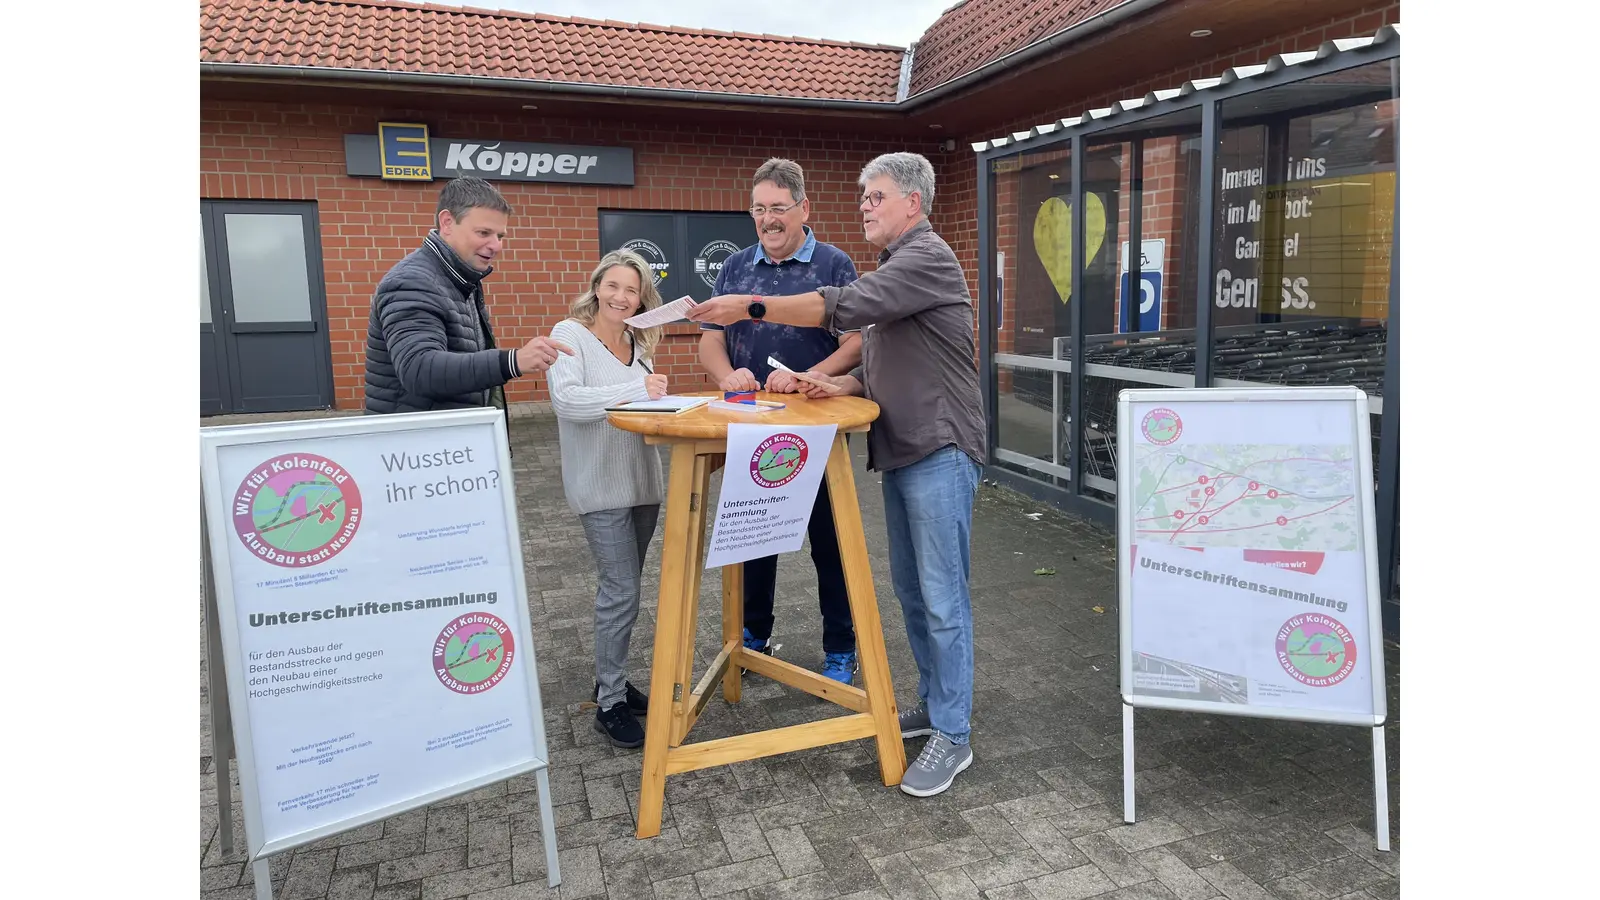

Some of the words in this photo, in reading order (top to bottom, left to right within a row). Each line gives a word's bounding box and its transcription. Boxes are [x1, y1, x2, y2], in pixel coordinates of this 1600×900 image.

[386, 167, 429, 177] EDEKA
[1296, 157, 1326, 180] uns
[1227, 203, 1244, 225] im
[1247, 196, 1312, 222] Abot:
[1235, 236, 1260, 260] Gan
[1215, 269, 1316, 310] Genss.
[381, 446, 474, 472] Wusstet
[752, 449, 762, 463] Wir
[761, 439, 773, 450] für
[774, 435, 806, 450] Kolenfeld
[236, 490, 253, 515] Wir
[247, 469, 269, 488] für
[271, 457, 348, 484] Kolenfeld
[386, 482, 417, 503] ihr
[424, 470, 500, 498] schon?
[721, 508, 767, 519] sammlung
[723, 496, 789, 508] Unterschriften-
[717, 523, 770, 536] Bestandsstrecke
[784, 517, 804, 526] gegen
[743, 517, 768, 525] Ausbau
[243, 532, 295, 564] Ausbau
[299, 548, 331, 564] statt
[330, 508, 359, 551] Neubau
[729, 534, 755, 542] Neubau
[756, 530, 772, 538] einer
[1290, 559, 1307, 568] wir?
[1141, 557, 1348, 613] Unterschriftensammlung
[249, 591, 498, 628] Unterschriftensammlung
[434, 639, 446, 657] Wir
[443, 624, 459, 638] für
[459, 614, 507, 634] Kolenfeld
[1278, 626, 1291, 641] Wir
[1289, 617, 1304, 628] für
[1306, 615, 1352, 643] Kolenfeld
[249, 652, 263, 661] für
[265, 649, 285, 659] den
[287, 645, 324, 656] Ausbau
[327, 642, 343, 651] der
[249, 656, 332, 673] Bestandsstrecke
[334, 652, 352, 662] und
[355, 648, 384, 661] gegen
[249, 676, 268, 686] den
[271, 671, 310, 683] Neubau
[313, 667, 338, 677] einer
[437, 668, 469, 692] Ausbau
[471, 680, 491, 692] statt
[491, 651, 512, 682] Neubau
[1278, 651, 1305, 681] Ausbau
[1306, 677, 1327, 685] statt
[1328, 660, 1353, 684] Neubau
[249, 672, 383, 698] Hochgeschwindigkeitsstrecke
